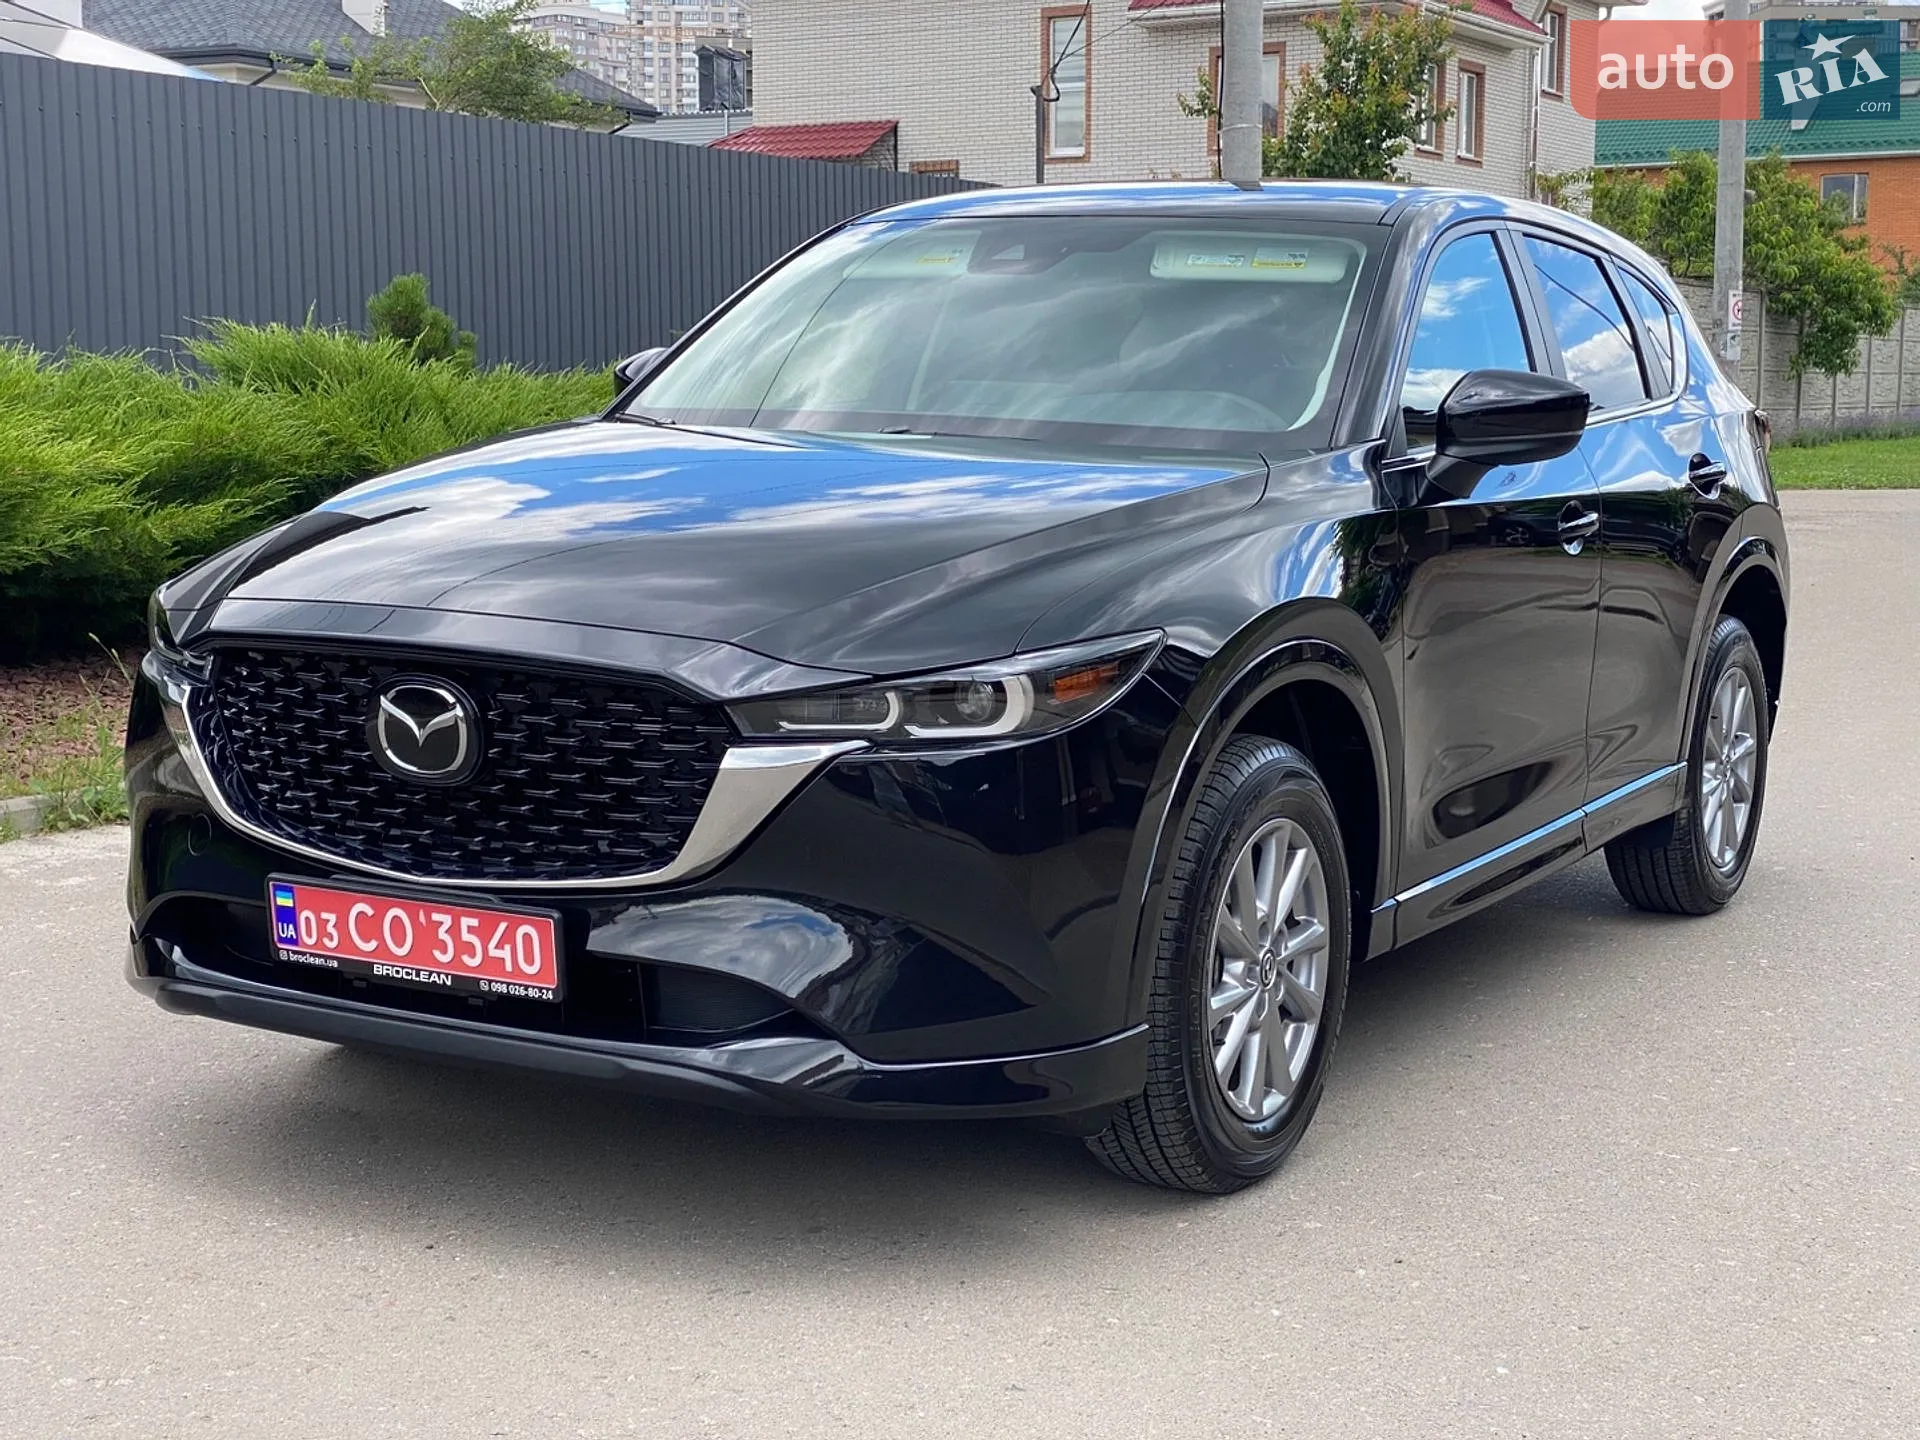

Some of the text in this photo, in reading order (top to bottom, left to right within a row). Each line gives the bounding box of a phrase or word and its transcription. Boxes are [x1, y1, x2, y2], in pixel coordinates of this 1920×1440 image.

[278, 921, 297, 940] UA
[299, 902, 543, 975] 03 CO 3540
[289, 951, 338, 968] broclean.ua
[373, 964, 451, 986] BROCLEAN
[490, 981, 553, 1000] 098 026-80-24
